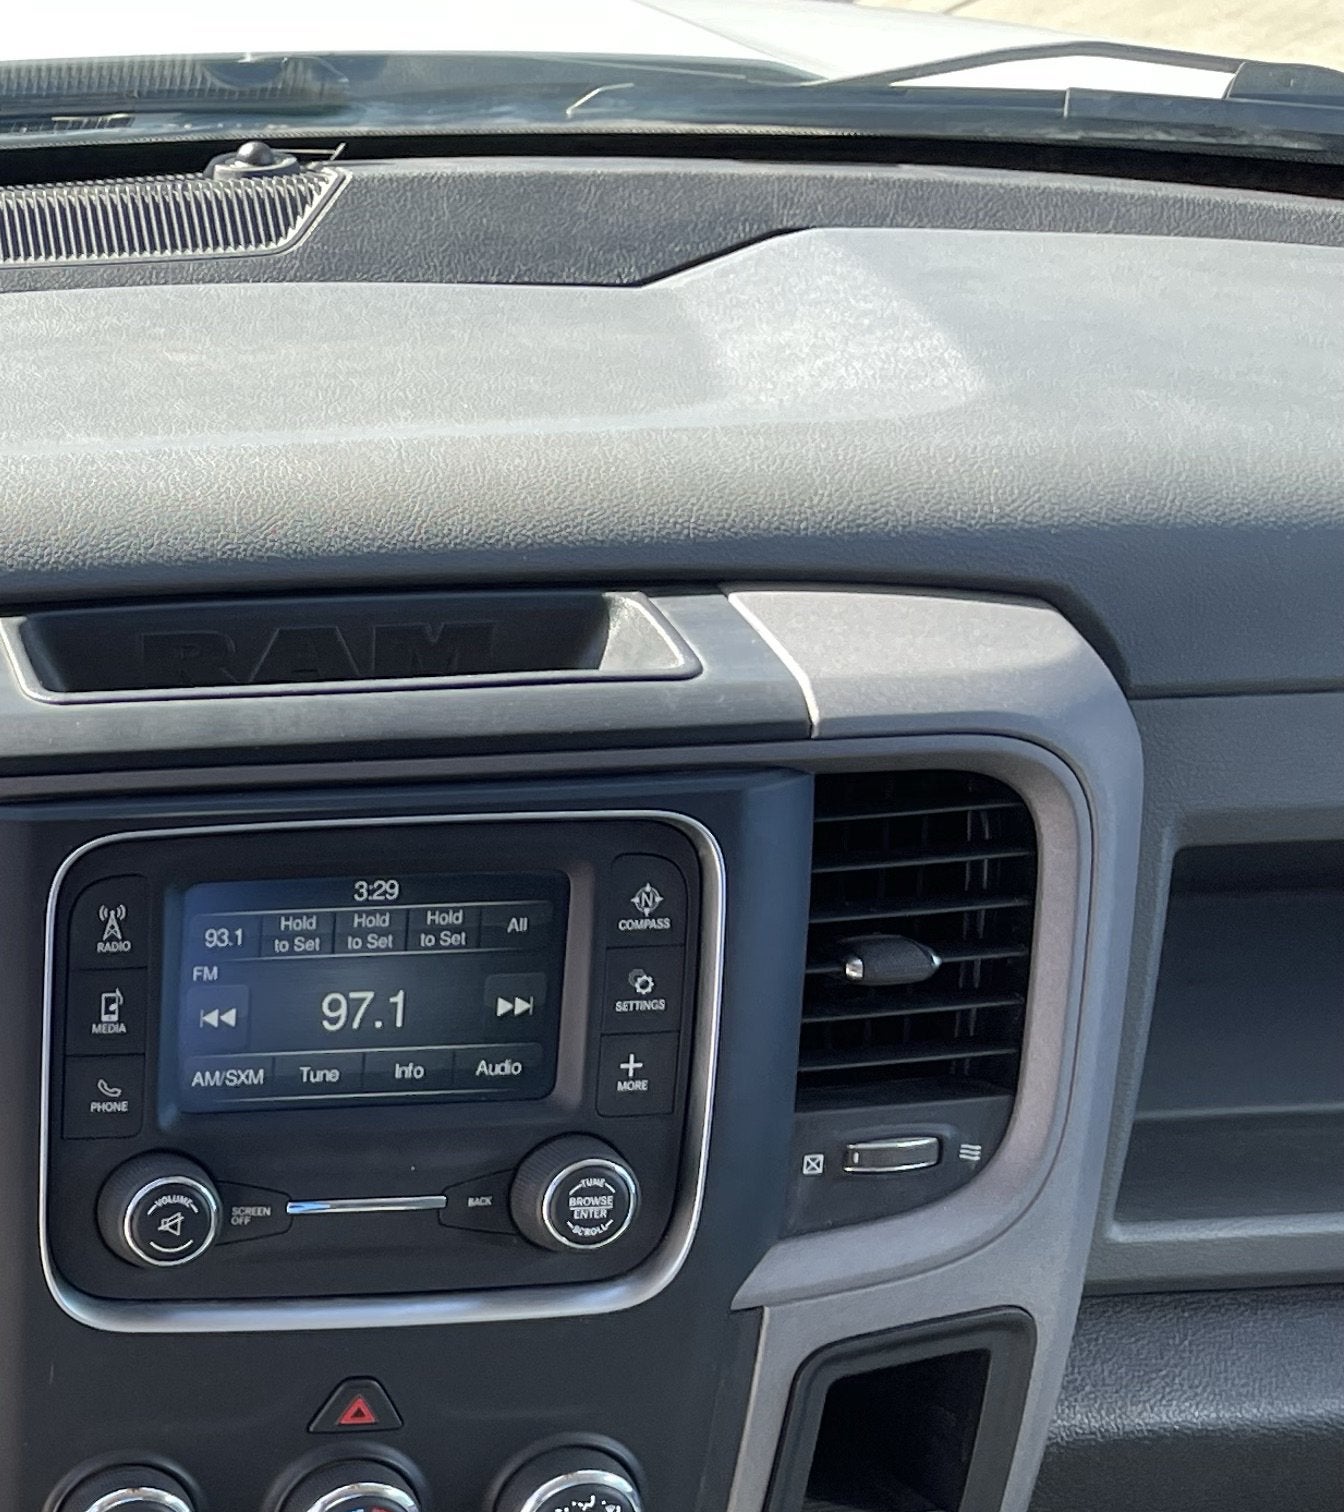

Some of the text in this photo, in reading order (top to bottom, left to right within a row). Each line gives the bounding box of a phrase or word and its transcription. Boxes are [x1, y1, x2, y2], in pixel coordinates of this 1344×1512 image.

[140, 620, 495, 684] RAM
[354, 880, 399, 901] 3:29
[280, 915, 317, 931] Hold
[353, 912, 390, 928] Hold
[426, 910, 463, 926] Hold
[507, 918, 528, 933] All
[618, 917, 671, 931] COMPASS
[205, 928, 243, 948] 93.1
[274, 936, 320, 952] to Set
[347, 933, 393, 949] to Set
[420, 930, 466, 946] to Set
[97, 941, 131, 953] RADIO
[192, 966, 218, 981] FM
[321, 989, 405, 1032] 97.1
[615, 999, 665, 1013] SETTINGS
[91, 1023, 127, 1034] MEDIA
[299, 1066, 340, 1083] Tune
[395, 1062, 424, 1080] Info
[475, 1059, 523, 1077] Audio
[191, 1068, 265, 1087] AM/SXM
[617, 1079, 649, 1092] MORE
[90, 1101, 128, 1112] PHONE
[580, 1178, 606, 1188] TUNE
[154, 1194, 193, 1208] VOLUME
[468, 1195, 493, 1207] BACK
[569, 1195, 613, 1207] BROWSE
[231, 1206, 271, 1217] SCREEN
[573, 1208, 608, 1220] ENTER
[231, 1217, 250, 1226] OFF
[572, 1223, 609, 1237] SCROLL
